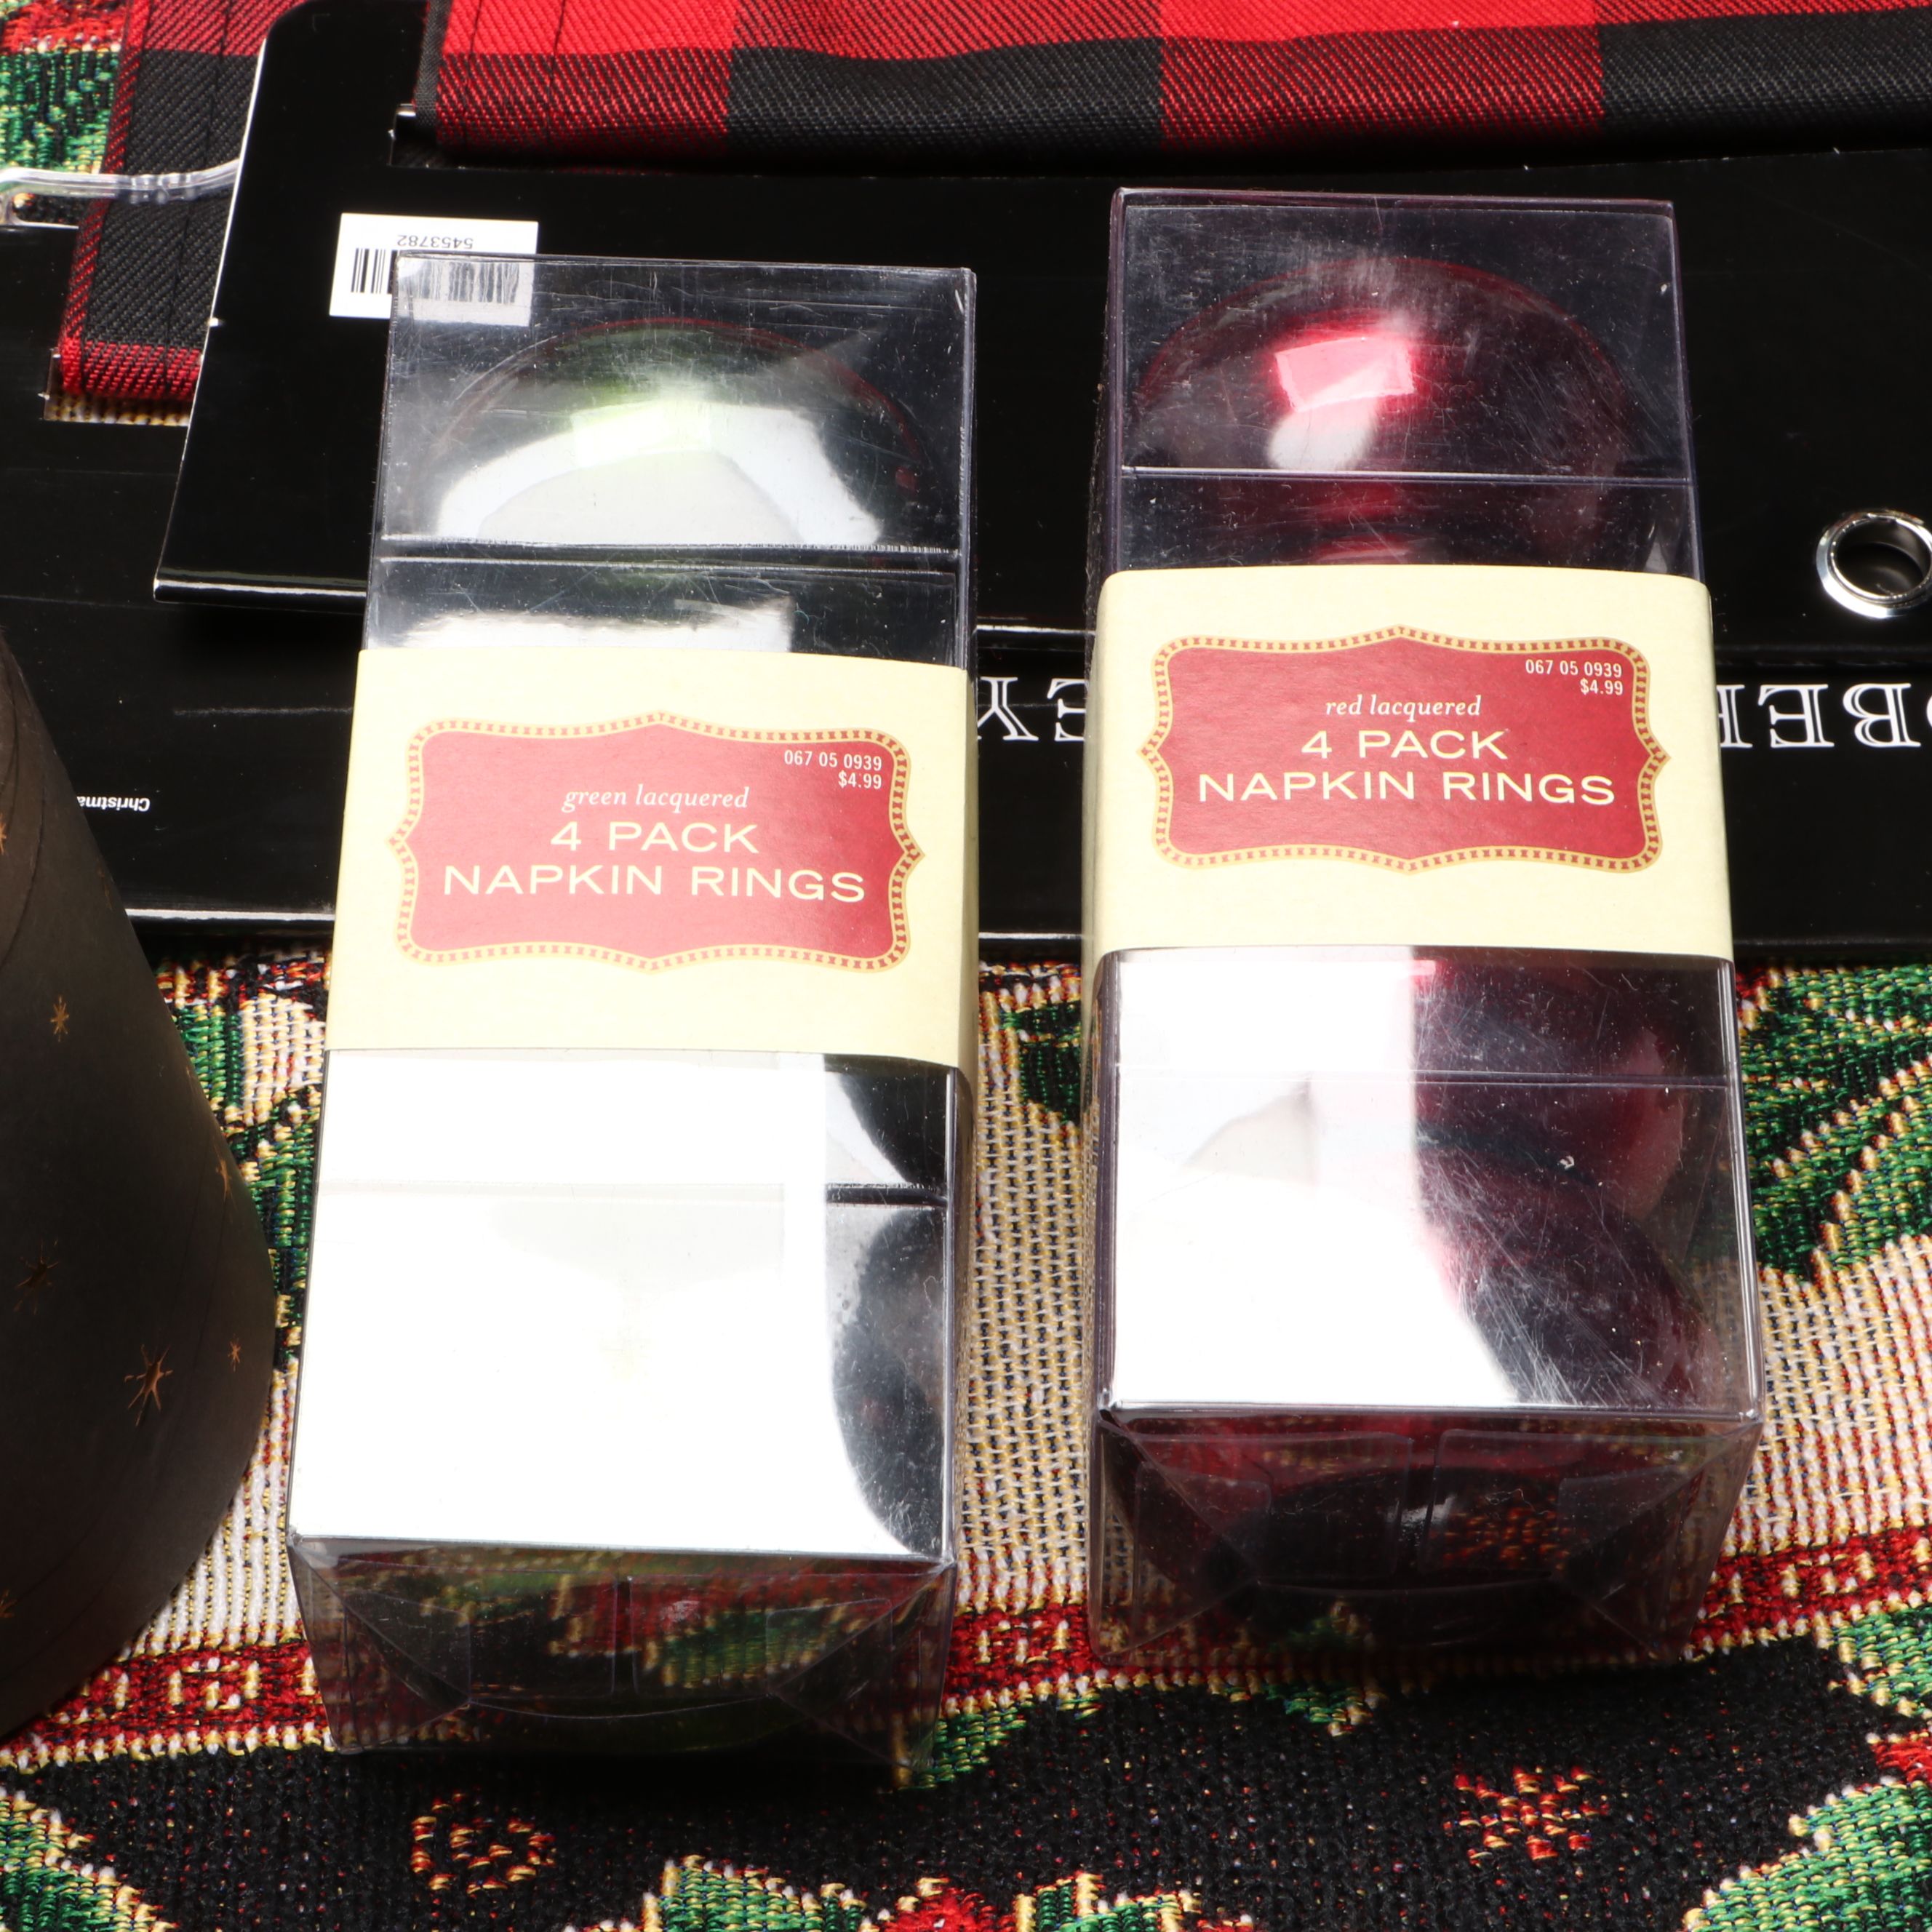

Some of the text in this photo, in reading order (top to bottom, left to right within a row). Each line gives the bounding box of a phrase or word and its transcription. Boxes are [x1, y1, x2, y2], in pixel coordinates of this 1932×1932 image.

[396, 235, 474, 250] 5453782
[1525, 659, 1622, 678] 067 05 0939
[1580, 678, 1624, 696] $4.99
[1325, 694, 1482, 722] red lacquered
[1301, 729, 1509, 761] 4 PACK
[783, 749, 882, 771] 067 05 0939
[838, 770, 882, 790] $4.99
[1199, 770, 1615, 806] NAPKIN RINGS
[76, 796, 151, 812] Christma
[561, 783, 750, 813] green lacquered
[550, 821, 759, 854] 4 PACK
[444, 865, 865, 903] NAPKIN RINGS
